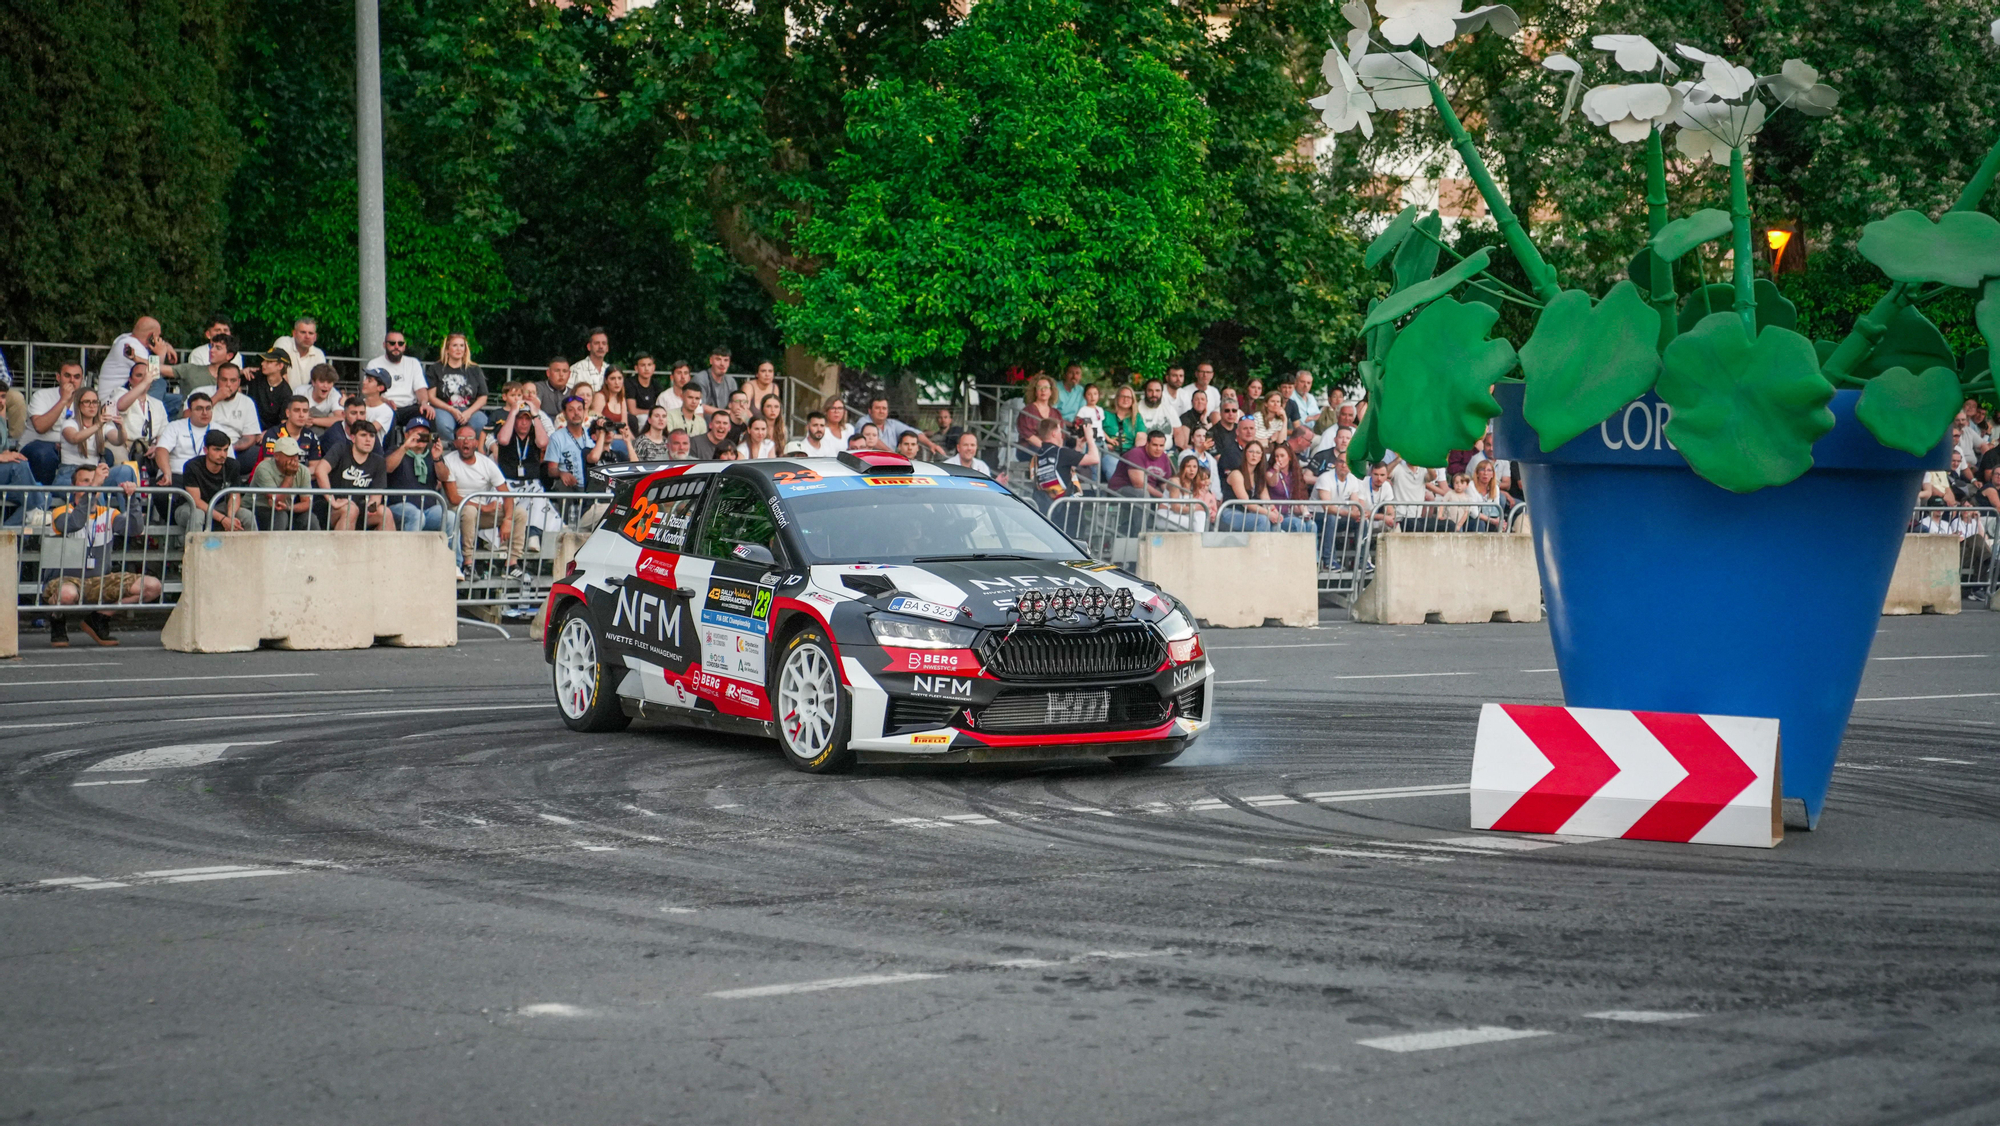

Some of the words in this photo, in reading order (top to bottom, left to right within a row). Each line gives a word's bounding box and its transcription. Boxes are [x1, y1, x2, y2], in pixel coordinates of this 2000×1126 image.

[773, 469, 824, 485] 23
[870, 477, 931, 485] PIRELLI
[623, 496, 659, 543] 23
[969, 575, 1091, 591] NFM
[708, 587, 720, 600] 43
[720, 588, 734, 597] RALLY
[753, 590, 771, 619] 23
[903, 600, 919, 611] BA
[921, 603, 931, 612] S
[932, 605, 954, 617] 323
[612, 586, 681, 648] NFM
[605, 632, 634, 646] NIVETTE
[634, 638, 649, 650] FLEET
[649, 644, 683, 662] MANAGEMENT
[924, 654, 958, 665] BERG
[701, 673, 720, 689] BERG
[1173, 663, 1197, 687] NFM
[914, 675, 972, 696] NFM
